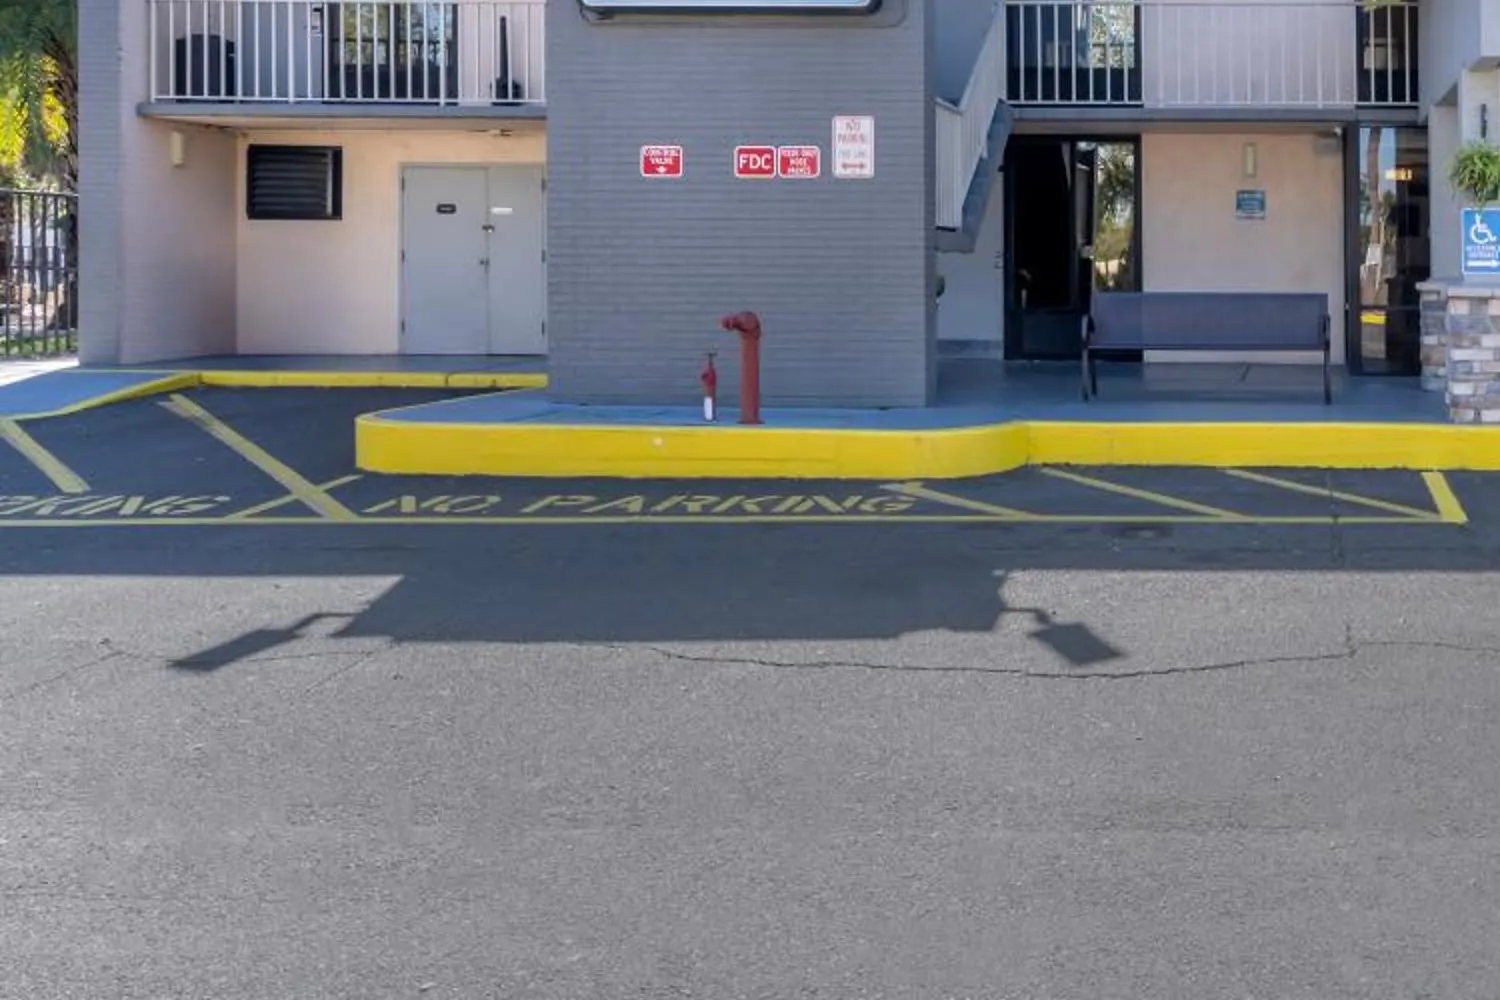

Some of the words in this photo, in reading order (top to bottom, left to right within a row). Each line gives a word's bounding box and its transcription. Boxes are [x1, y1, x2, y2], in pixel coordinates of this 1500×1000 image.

[739, 153, 772, 169] FDC
[361, 495, 502, 514] NO
[518, 494, 914, 514] PARKING
